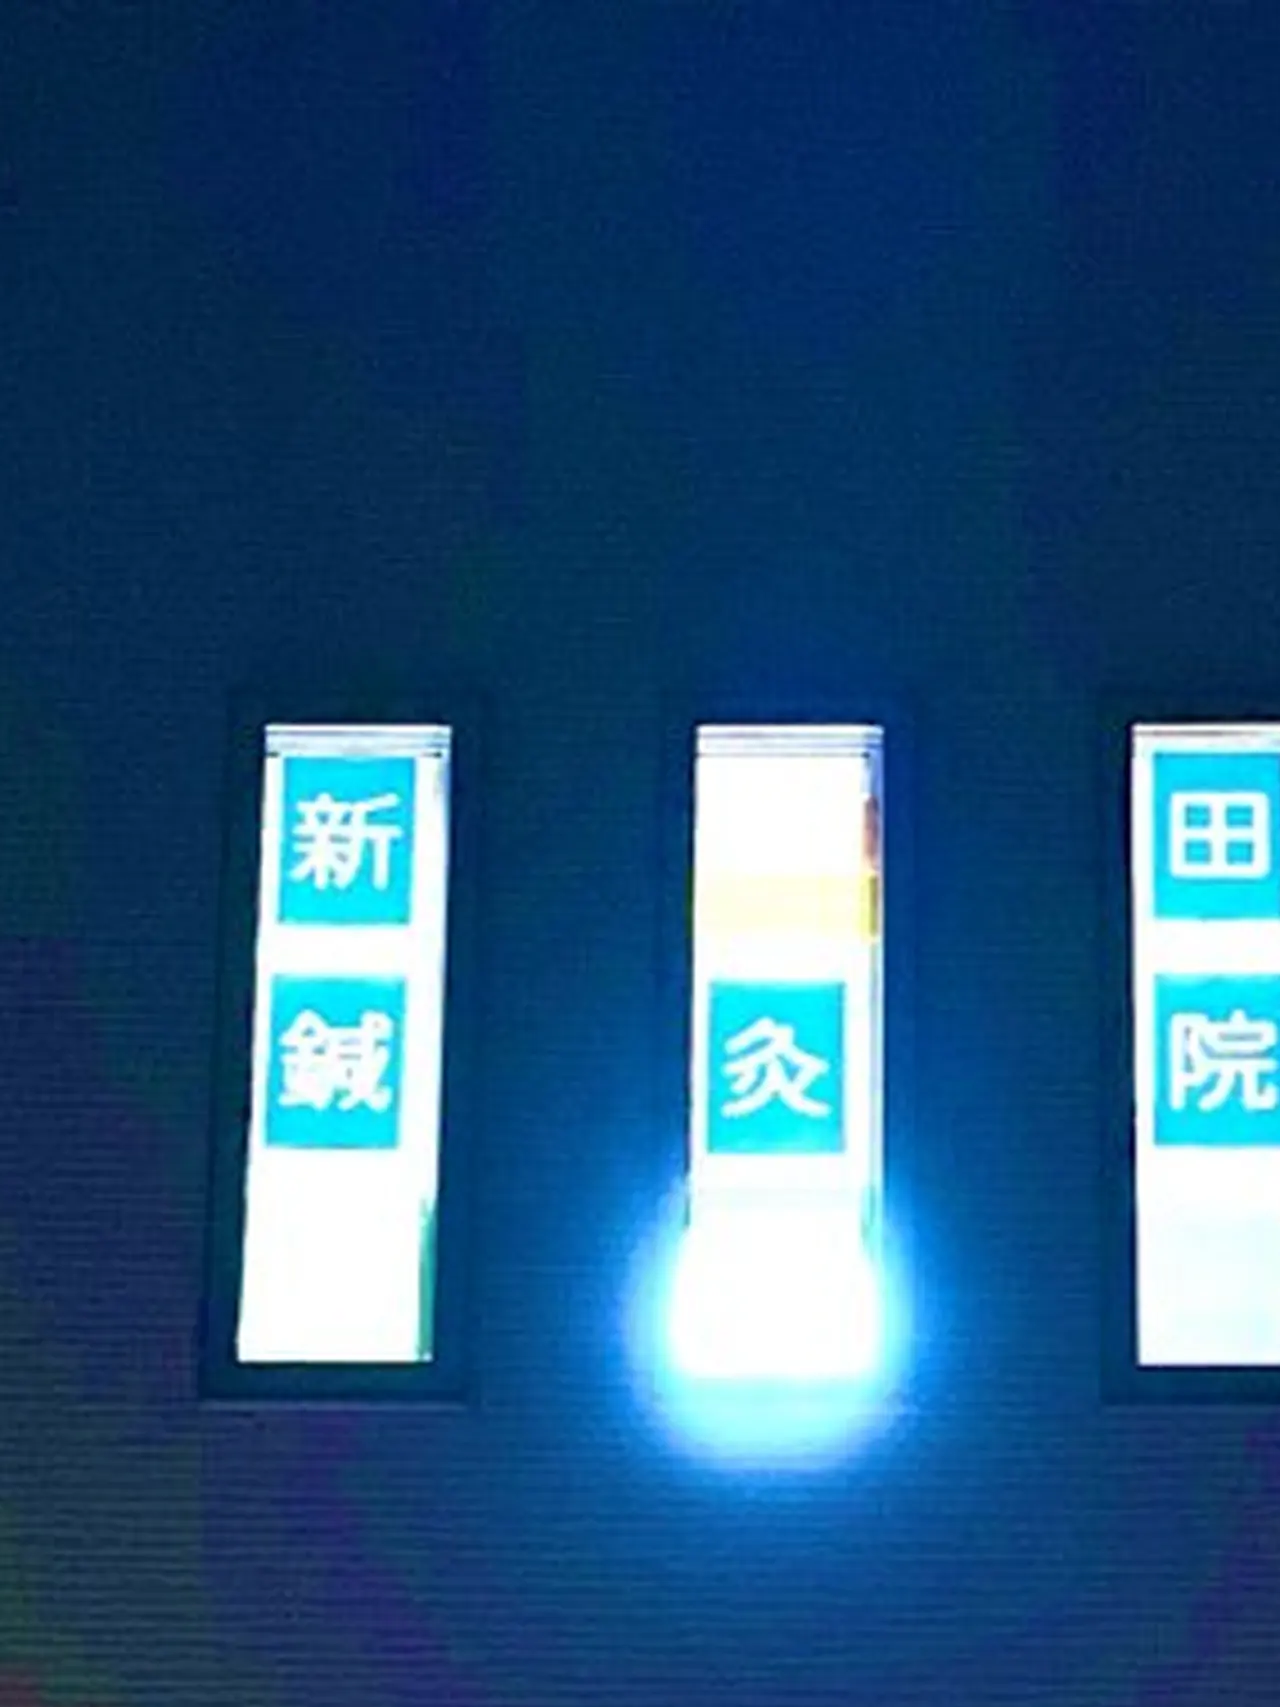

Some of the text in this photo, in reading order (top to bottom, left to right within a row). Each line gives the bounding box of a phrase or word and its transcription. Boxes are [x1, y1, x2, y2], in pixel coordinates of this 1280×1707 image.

[289, 790, 1273, 891] 新 田
[276, 1010, 396, 1112] 鍼
[720, 1016, 833, 1118] 灸
